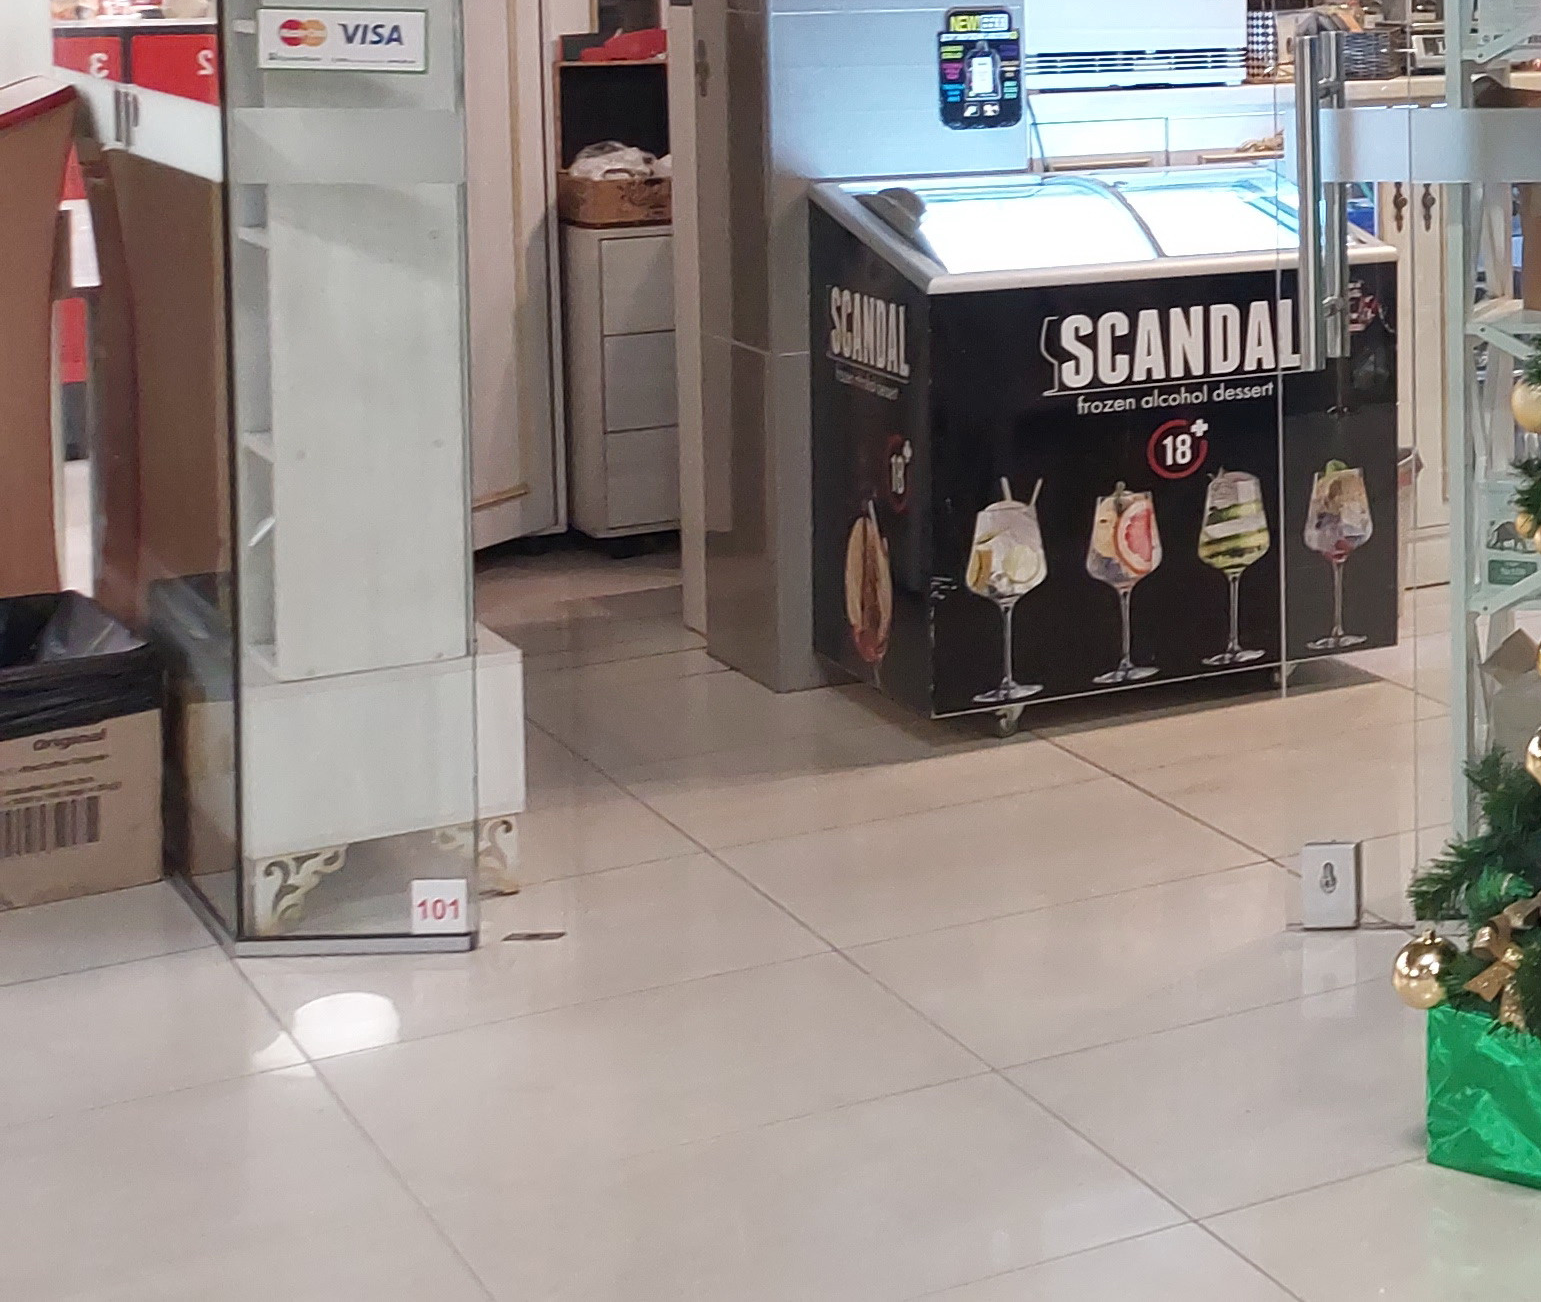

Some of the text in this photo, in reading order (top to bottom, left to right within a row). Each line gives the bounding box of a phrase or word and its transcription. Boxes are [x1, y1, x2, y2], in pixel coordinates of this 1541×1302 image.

[337, 23, 406, 47] VISA
[831, 285, 911, 378] SCANDAL
[1060, 298, 1302, 389] SCANDAL
[1076, 381, 1274, 416] frozen alcohol dessert
[418, 899, 461, 920] 101
